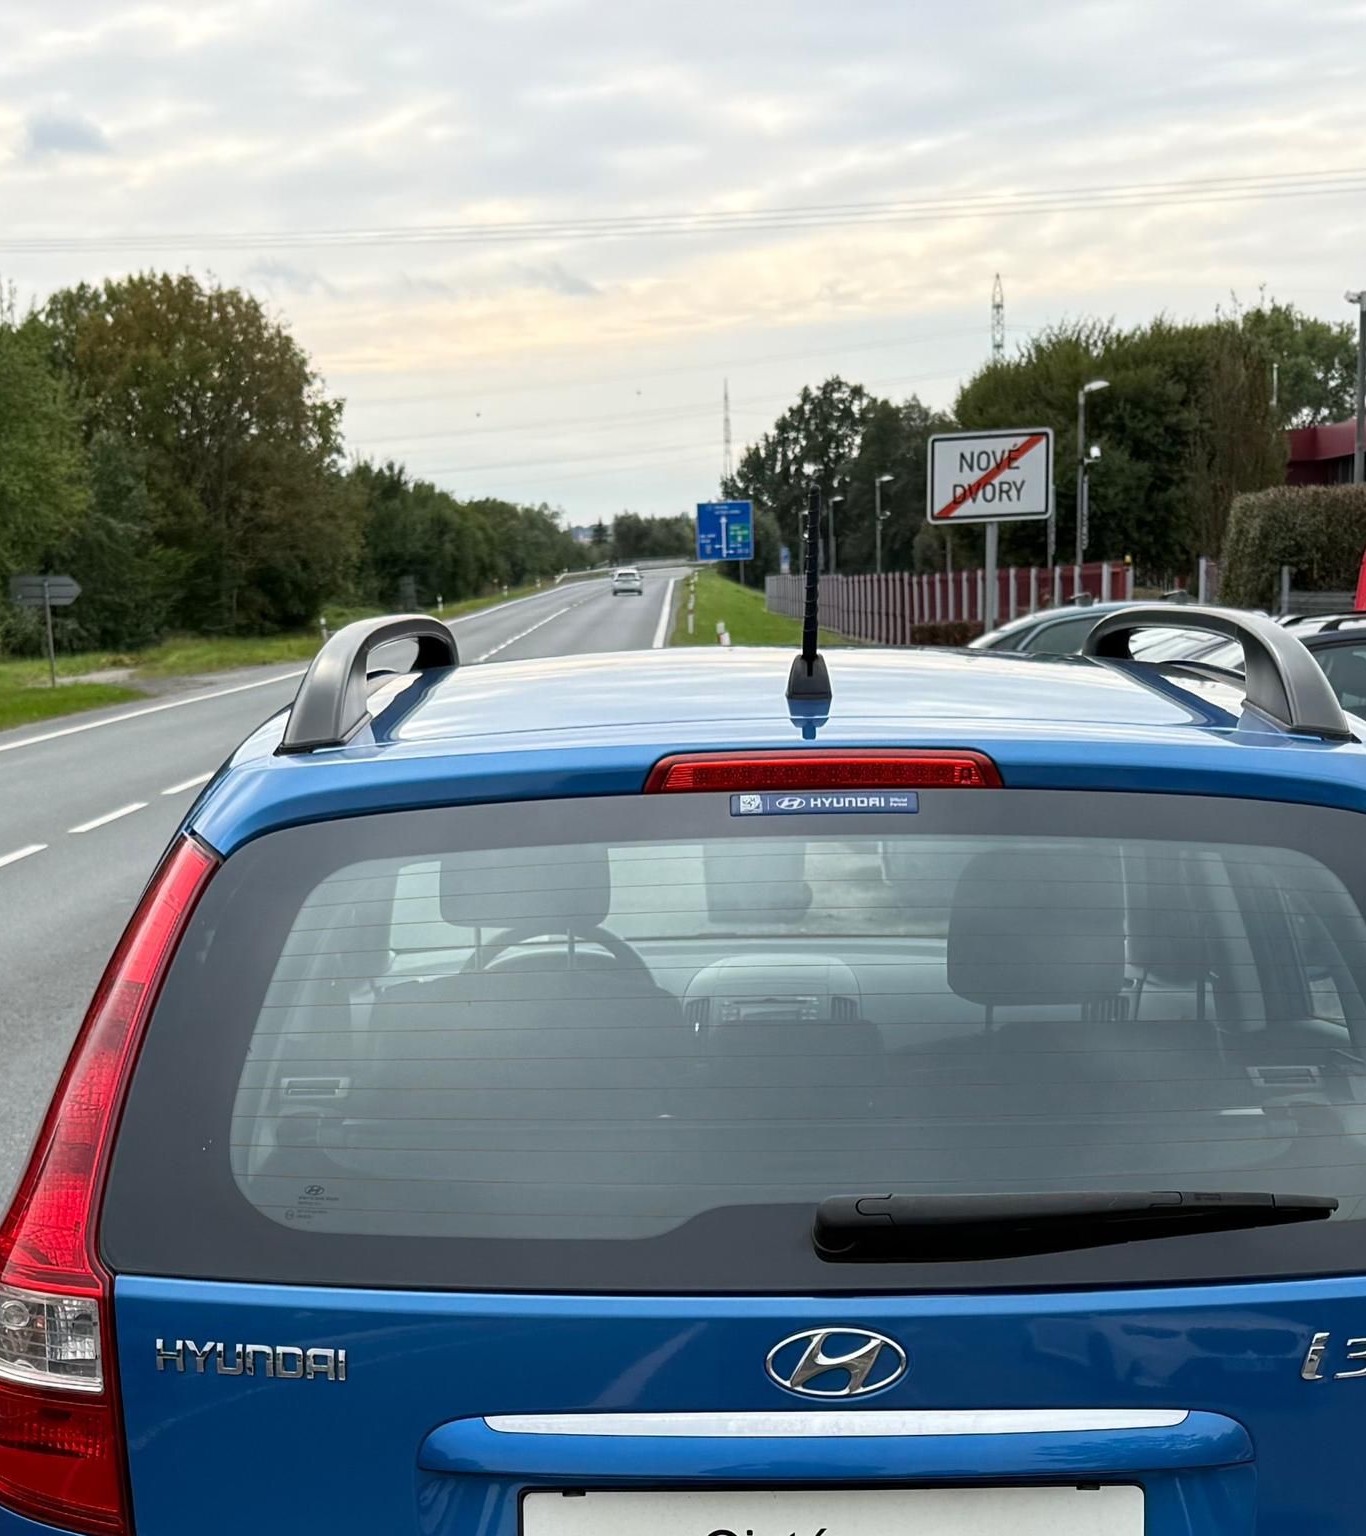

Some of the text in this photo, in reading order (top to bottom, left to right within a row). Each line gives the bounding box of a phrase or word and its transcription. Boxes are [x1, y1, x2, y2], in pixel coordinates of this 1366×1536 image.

[958, 442, 1021, 473] NOVÉ
[952, 478, 1026, 505] DVORY
[809, 796, 886, 809] HYUNDAI
[155, 1337, 347, 1381] HYUNDAI
